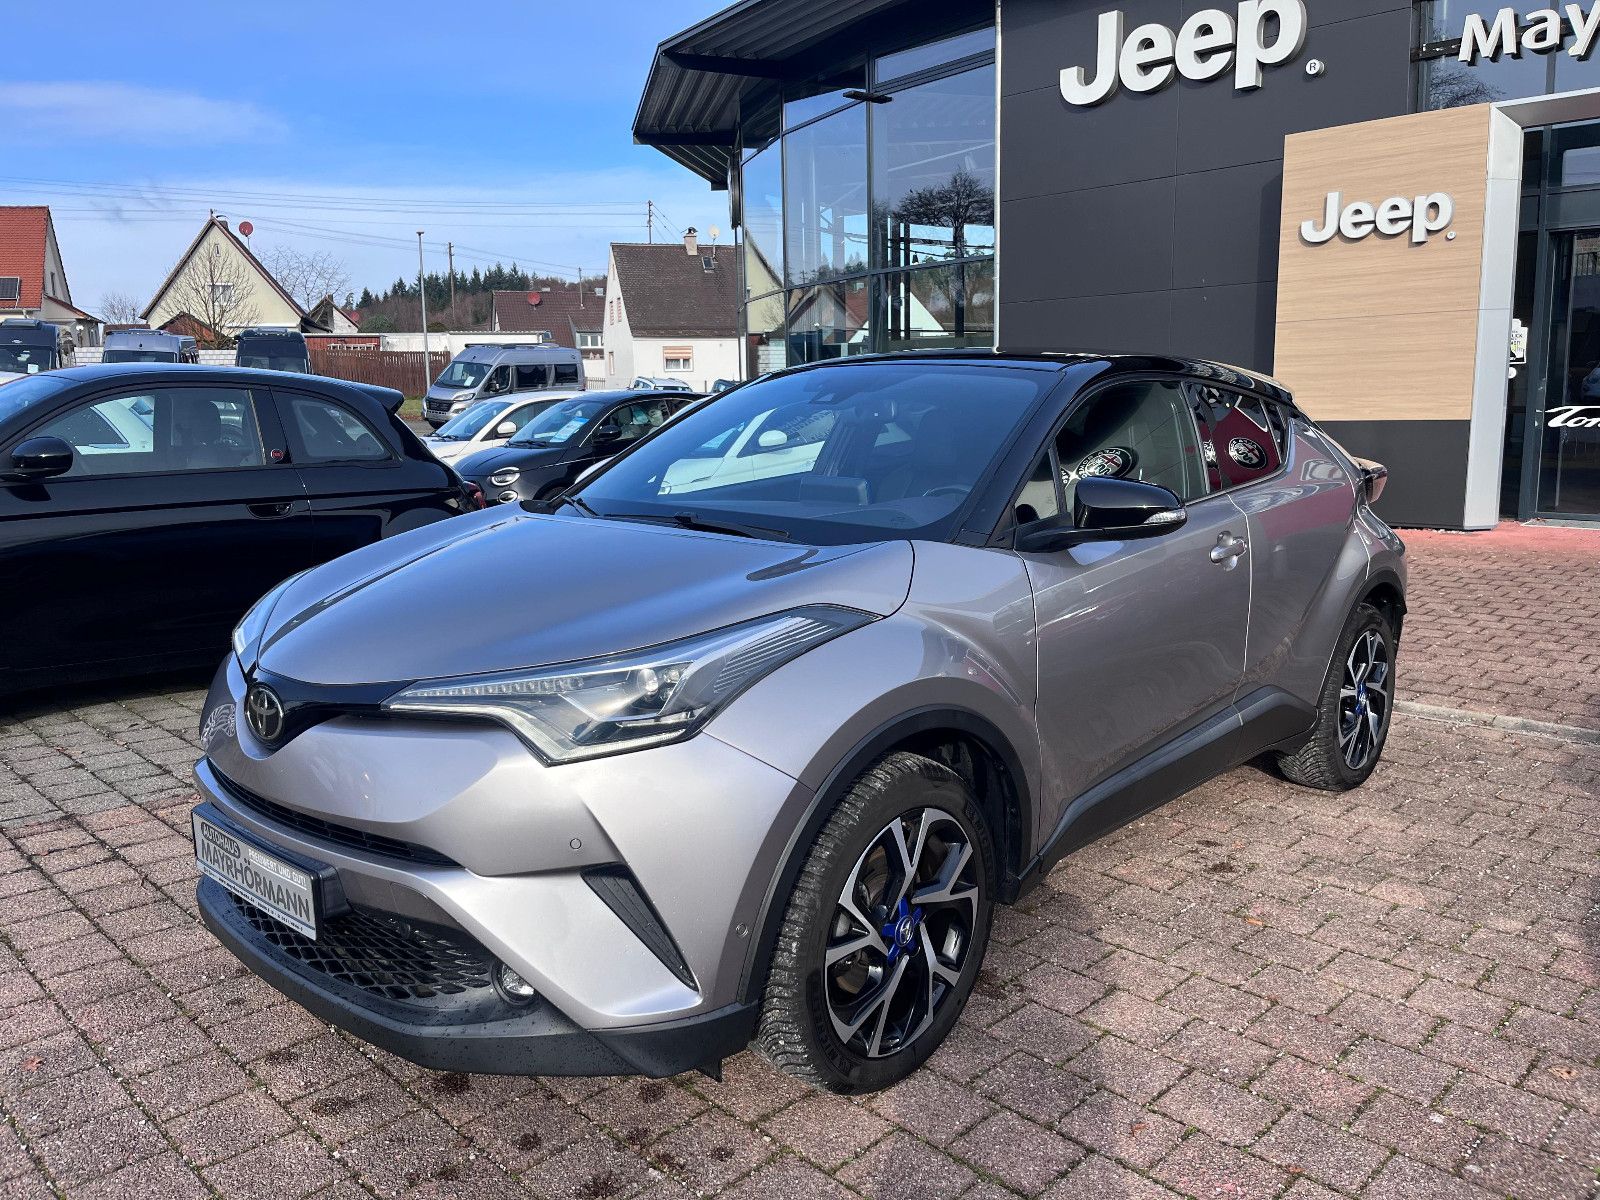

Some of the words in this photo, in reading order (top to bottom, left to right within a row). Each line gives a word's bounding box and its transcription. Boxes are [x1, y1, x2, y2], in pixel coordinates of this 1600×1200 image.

[1060, 0, 1305, 105] Jeep
[1458, 0, 1600, 61] May
[1300, 191, 1454, 243] Jeep
[203, 823, 239, 857] AUTOHAUS
[201, 838, 310, 922] MAYRHÖRMANN
